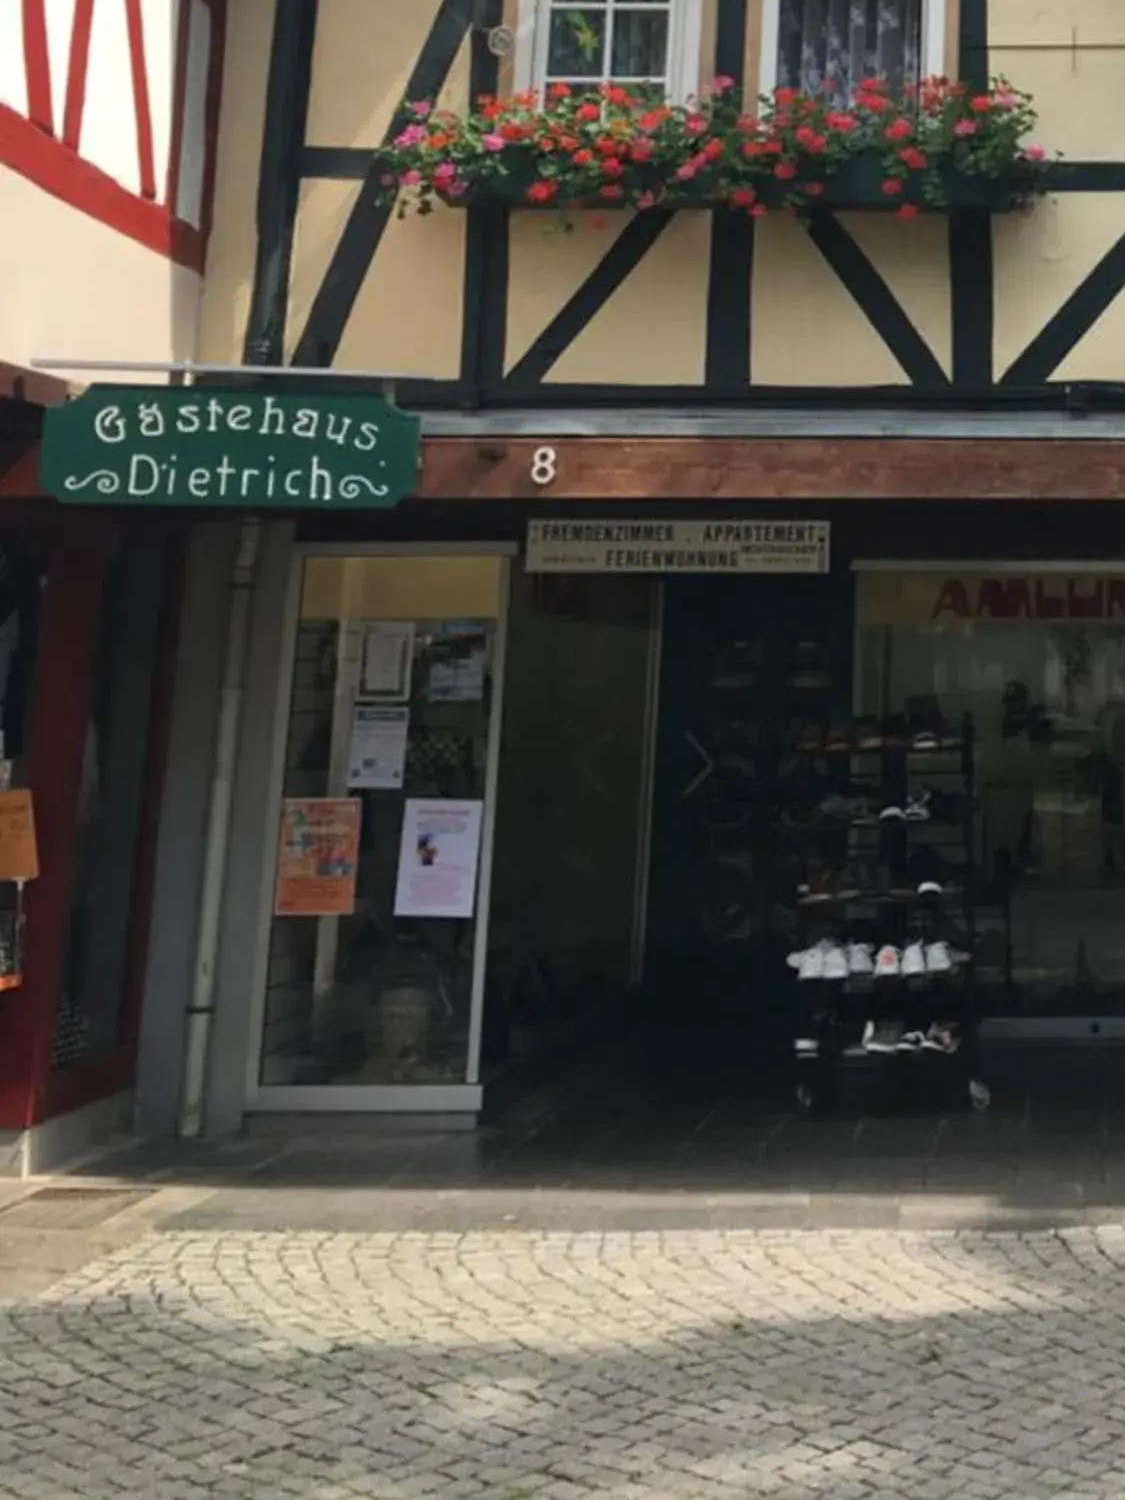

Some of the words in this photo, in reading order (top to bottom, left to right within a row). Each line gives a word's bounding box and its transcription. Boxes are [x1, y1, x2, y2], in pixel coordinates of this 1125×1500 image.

[94, 396, 380, 451] Gästehaus
[127, 454, 332, 501] Dietrich
[531, 445, 556, 485] 8
